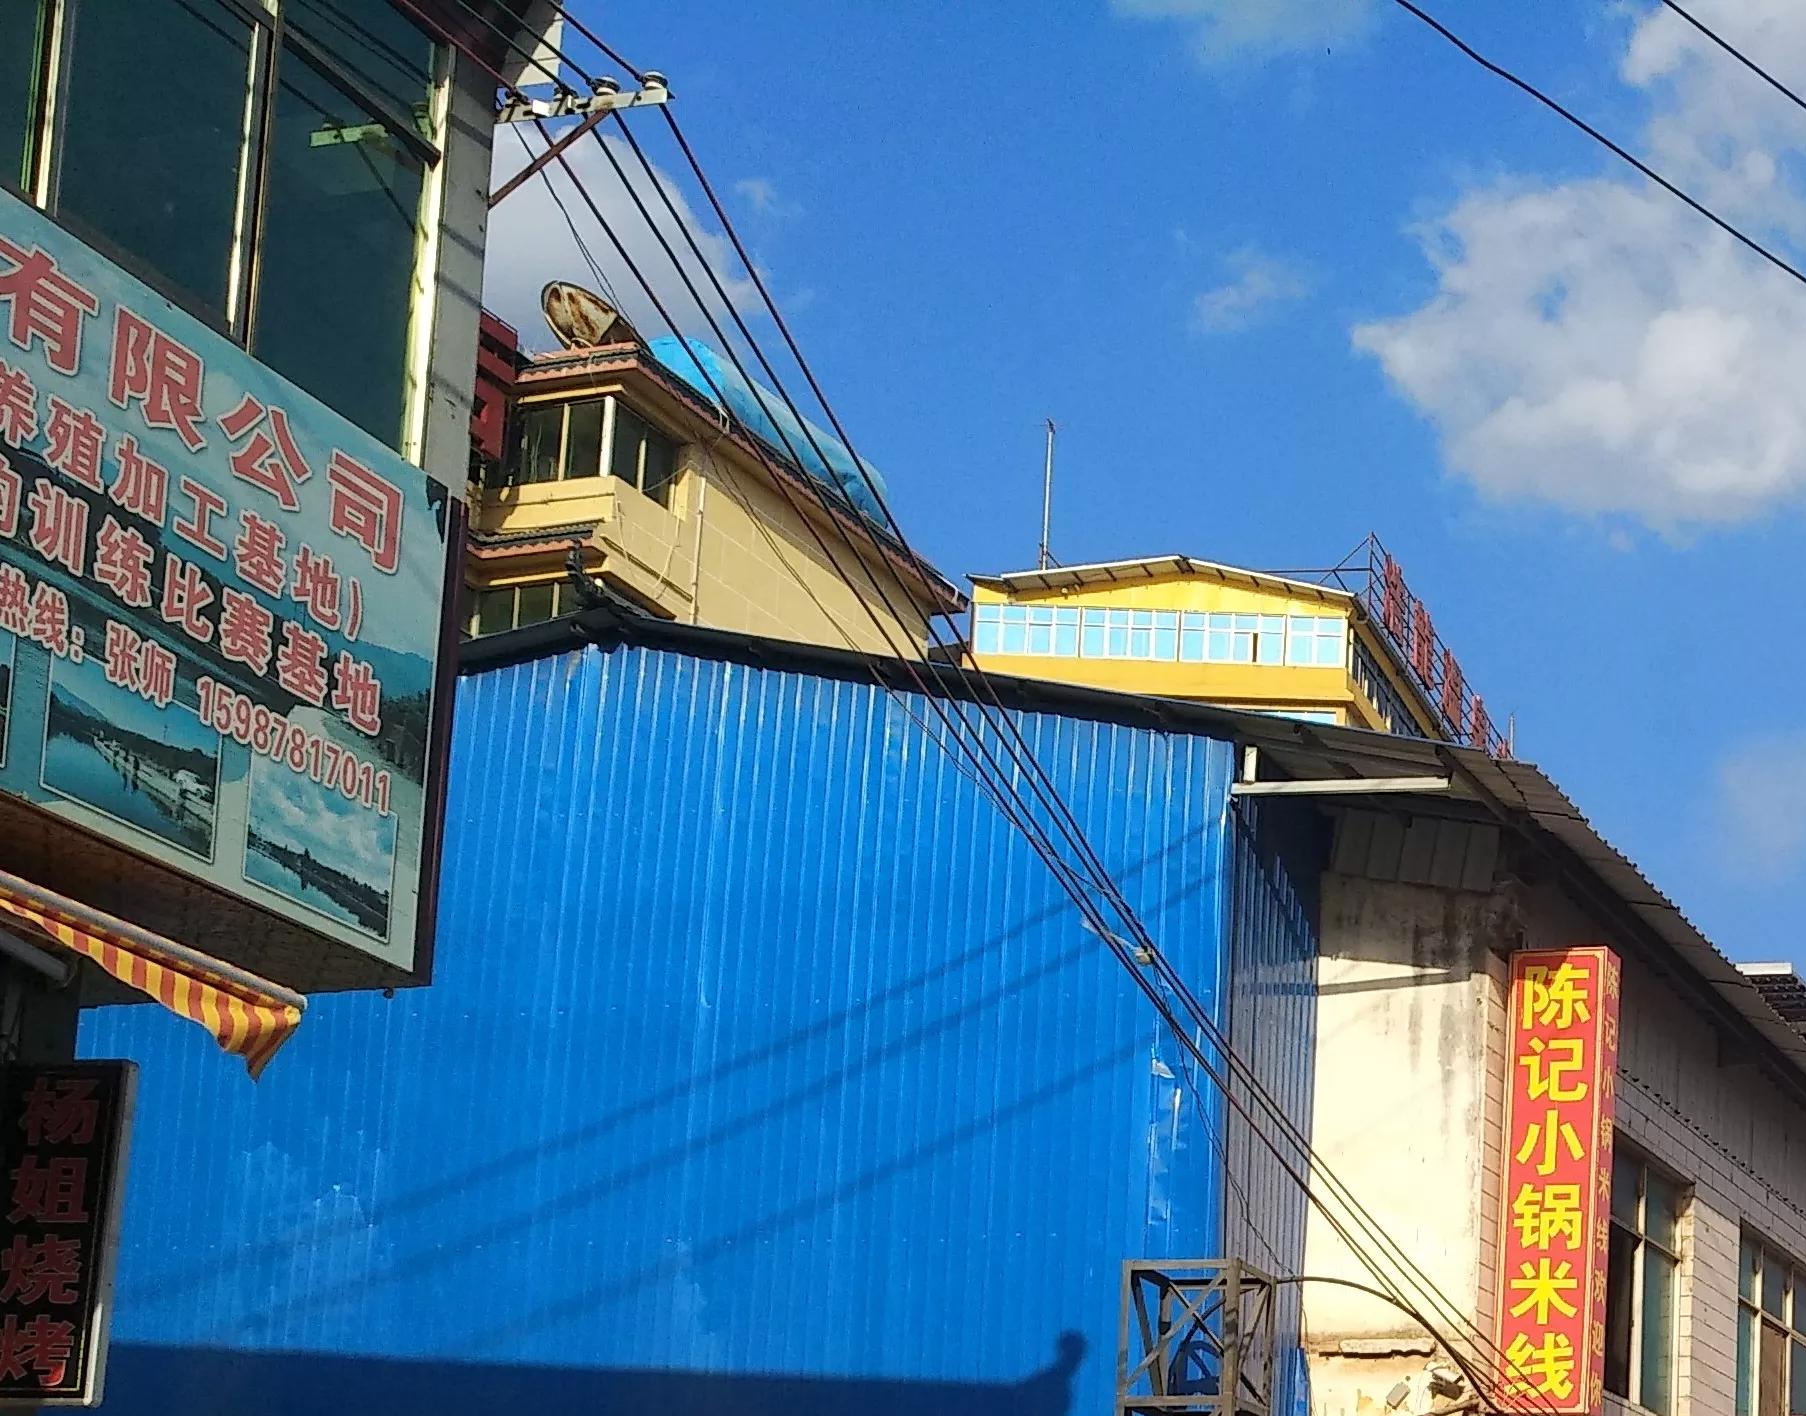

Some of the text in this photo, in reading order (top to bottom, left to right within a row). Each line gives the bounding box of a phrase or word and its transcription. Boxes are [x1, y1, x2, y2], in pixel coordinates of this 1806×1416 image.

[0, 234, 404, 572] 有限公司
[197, 676, 391, 816] 15987817011
[0, 1075, 100, 1387] 杨姐烧烤
[1504, 964, 1591, 1399] 陈记小锅米线
